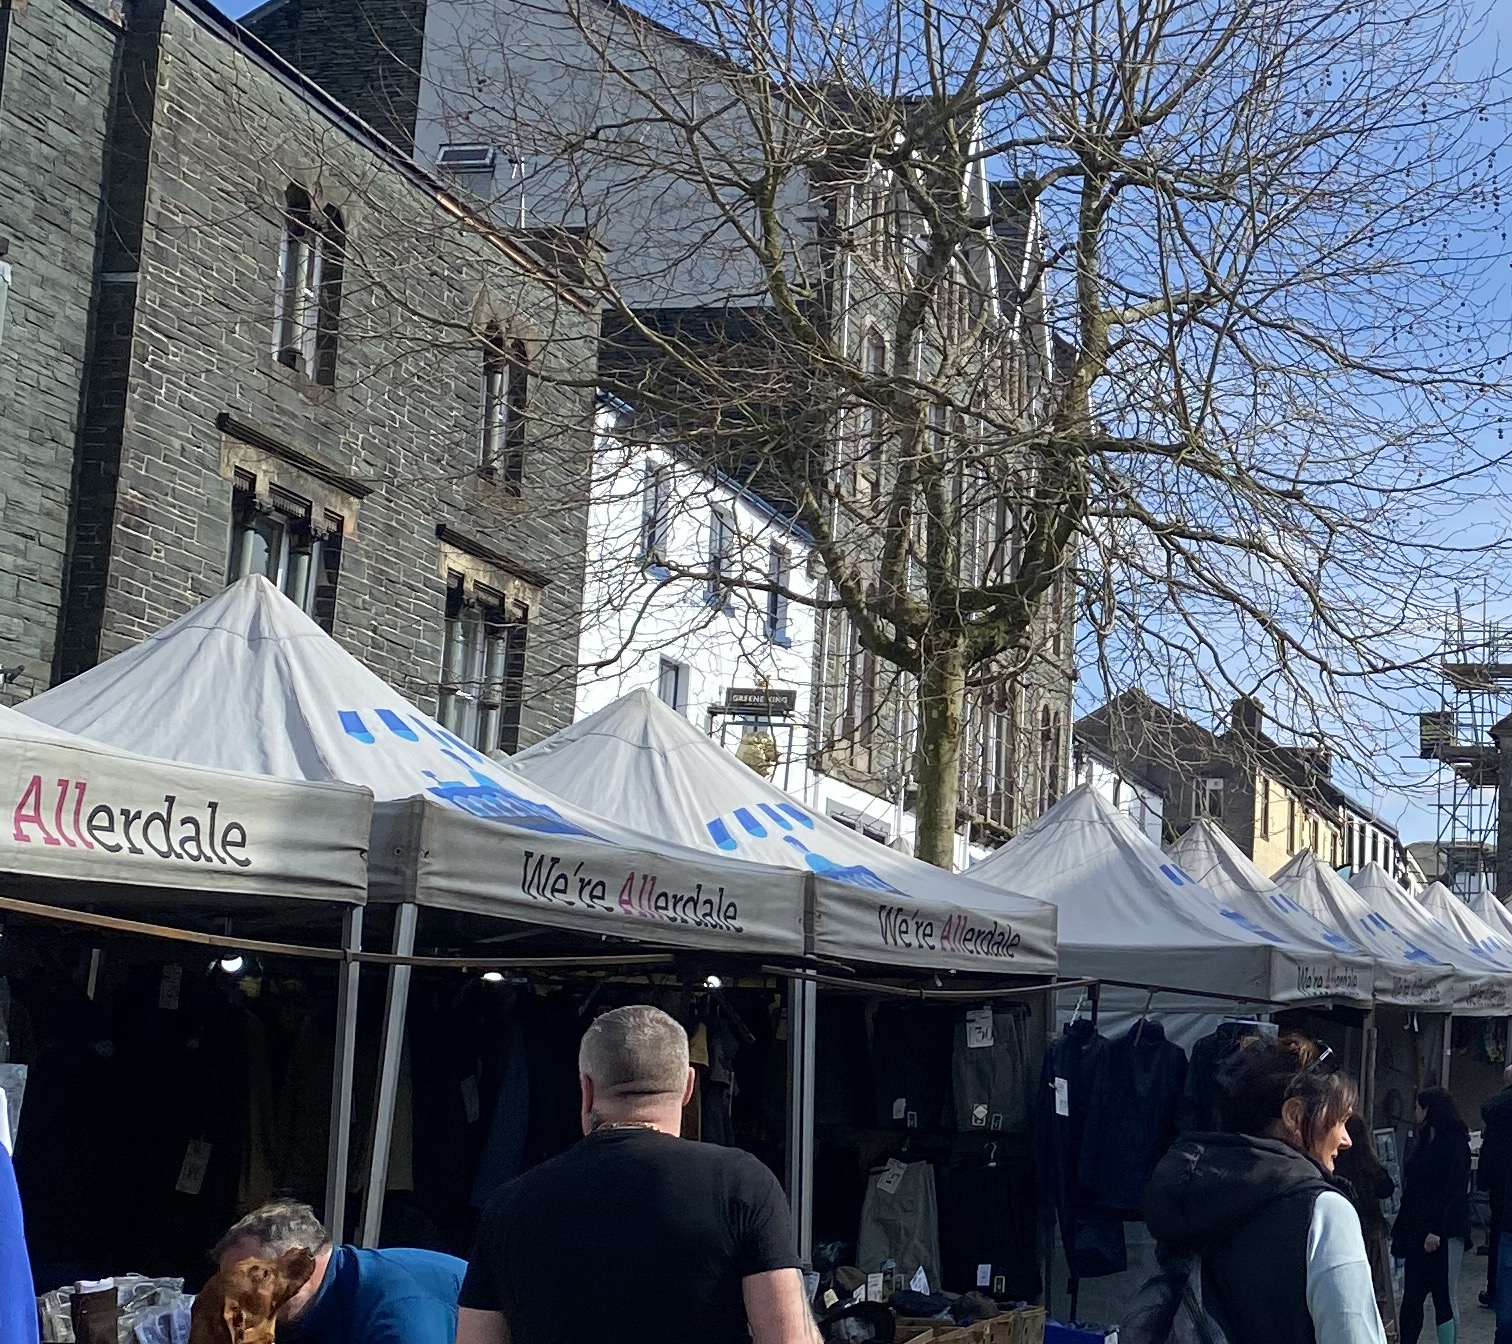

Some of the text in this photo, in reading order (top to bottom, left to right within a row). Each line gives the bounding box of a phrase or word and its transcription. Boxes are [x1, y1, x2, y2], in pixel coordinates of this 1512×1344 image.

[13, 774, 252, 868] Allerdale
[521, 850, 744, 934] We're Allerdale
[878, 904, 1021, 959] We're Allerdale
